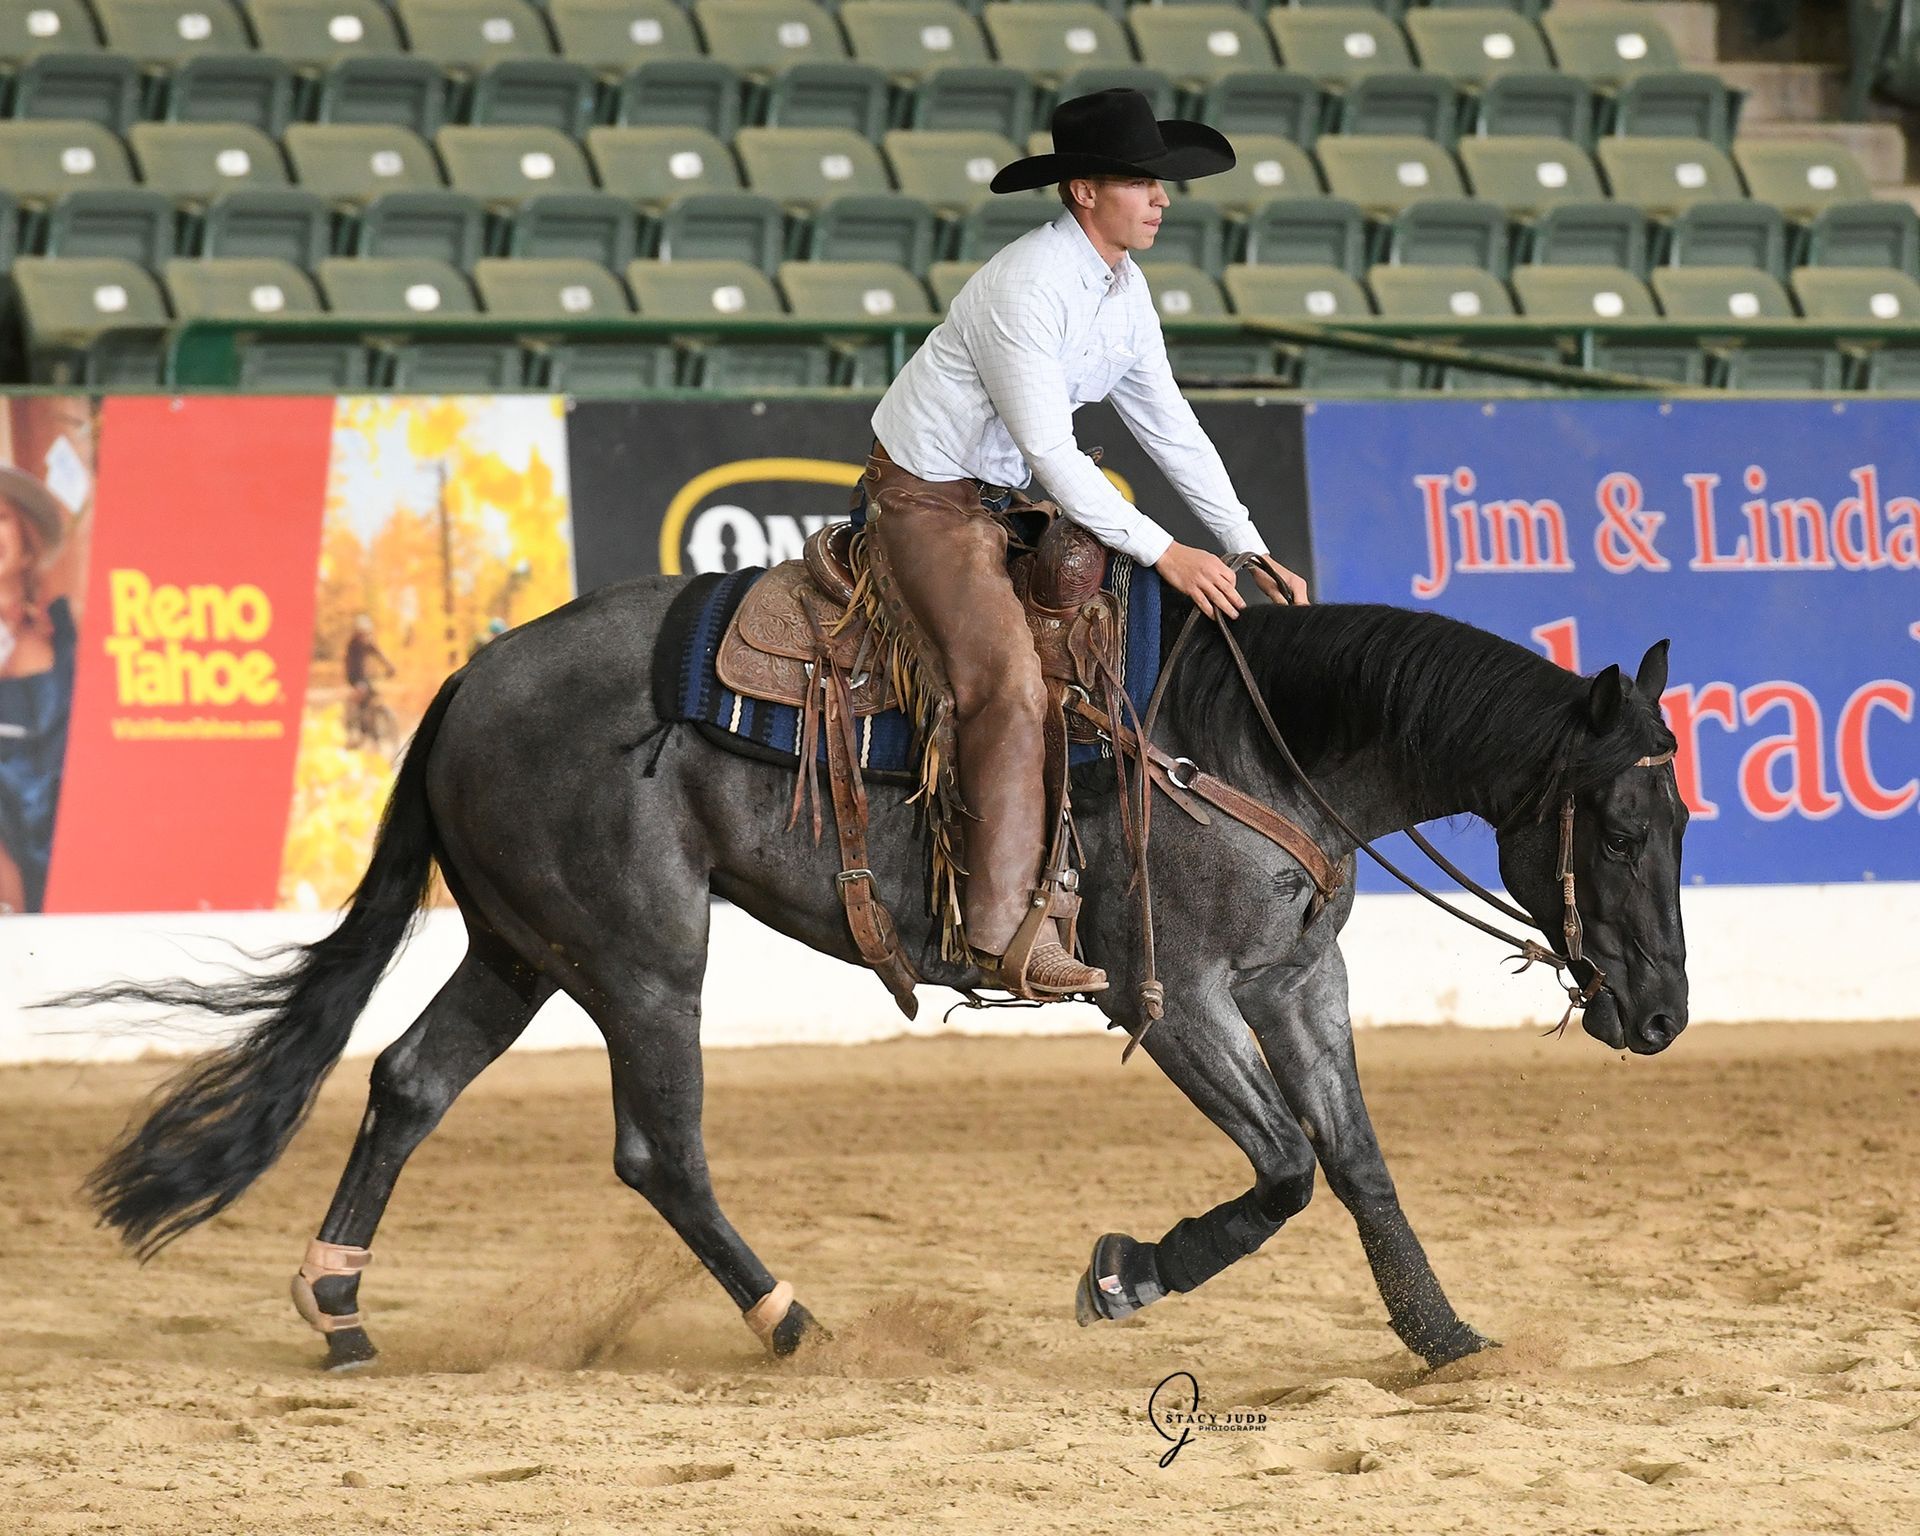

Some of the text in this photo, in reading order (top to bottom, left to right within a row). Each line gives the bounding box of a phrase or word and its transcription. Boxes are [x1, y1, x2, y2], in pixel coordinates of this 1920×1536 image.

[1412, 465, 1920, 598] Jim & Linda
[110, 569, 272, 641] Reno
[104, 634, 280, 705] Tahoe
